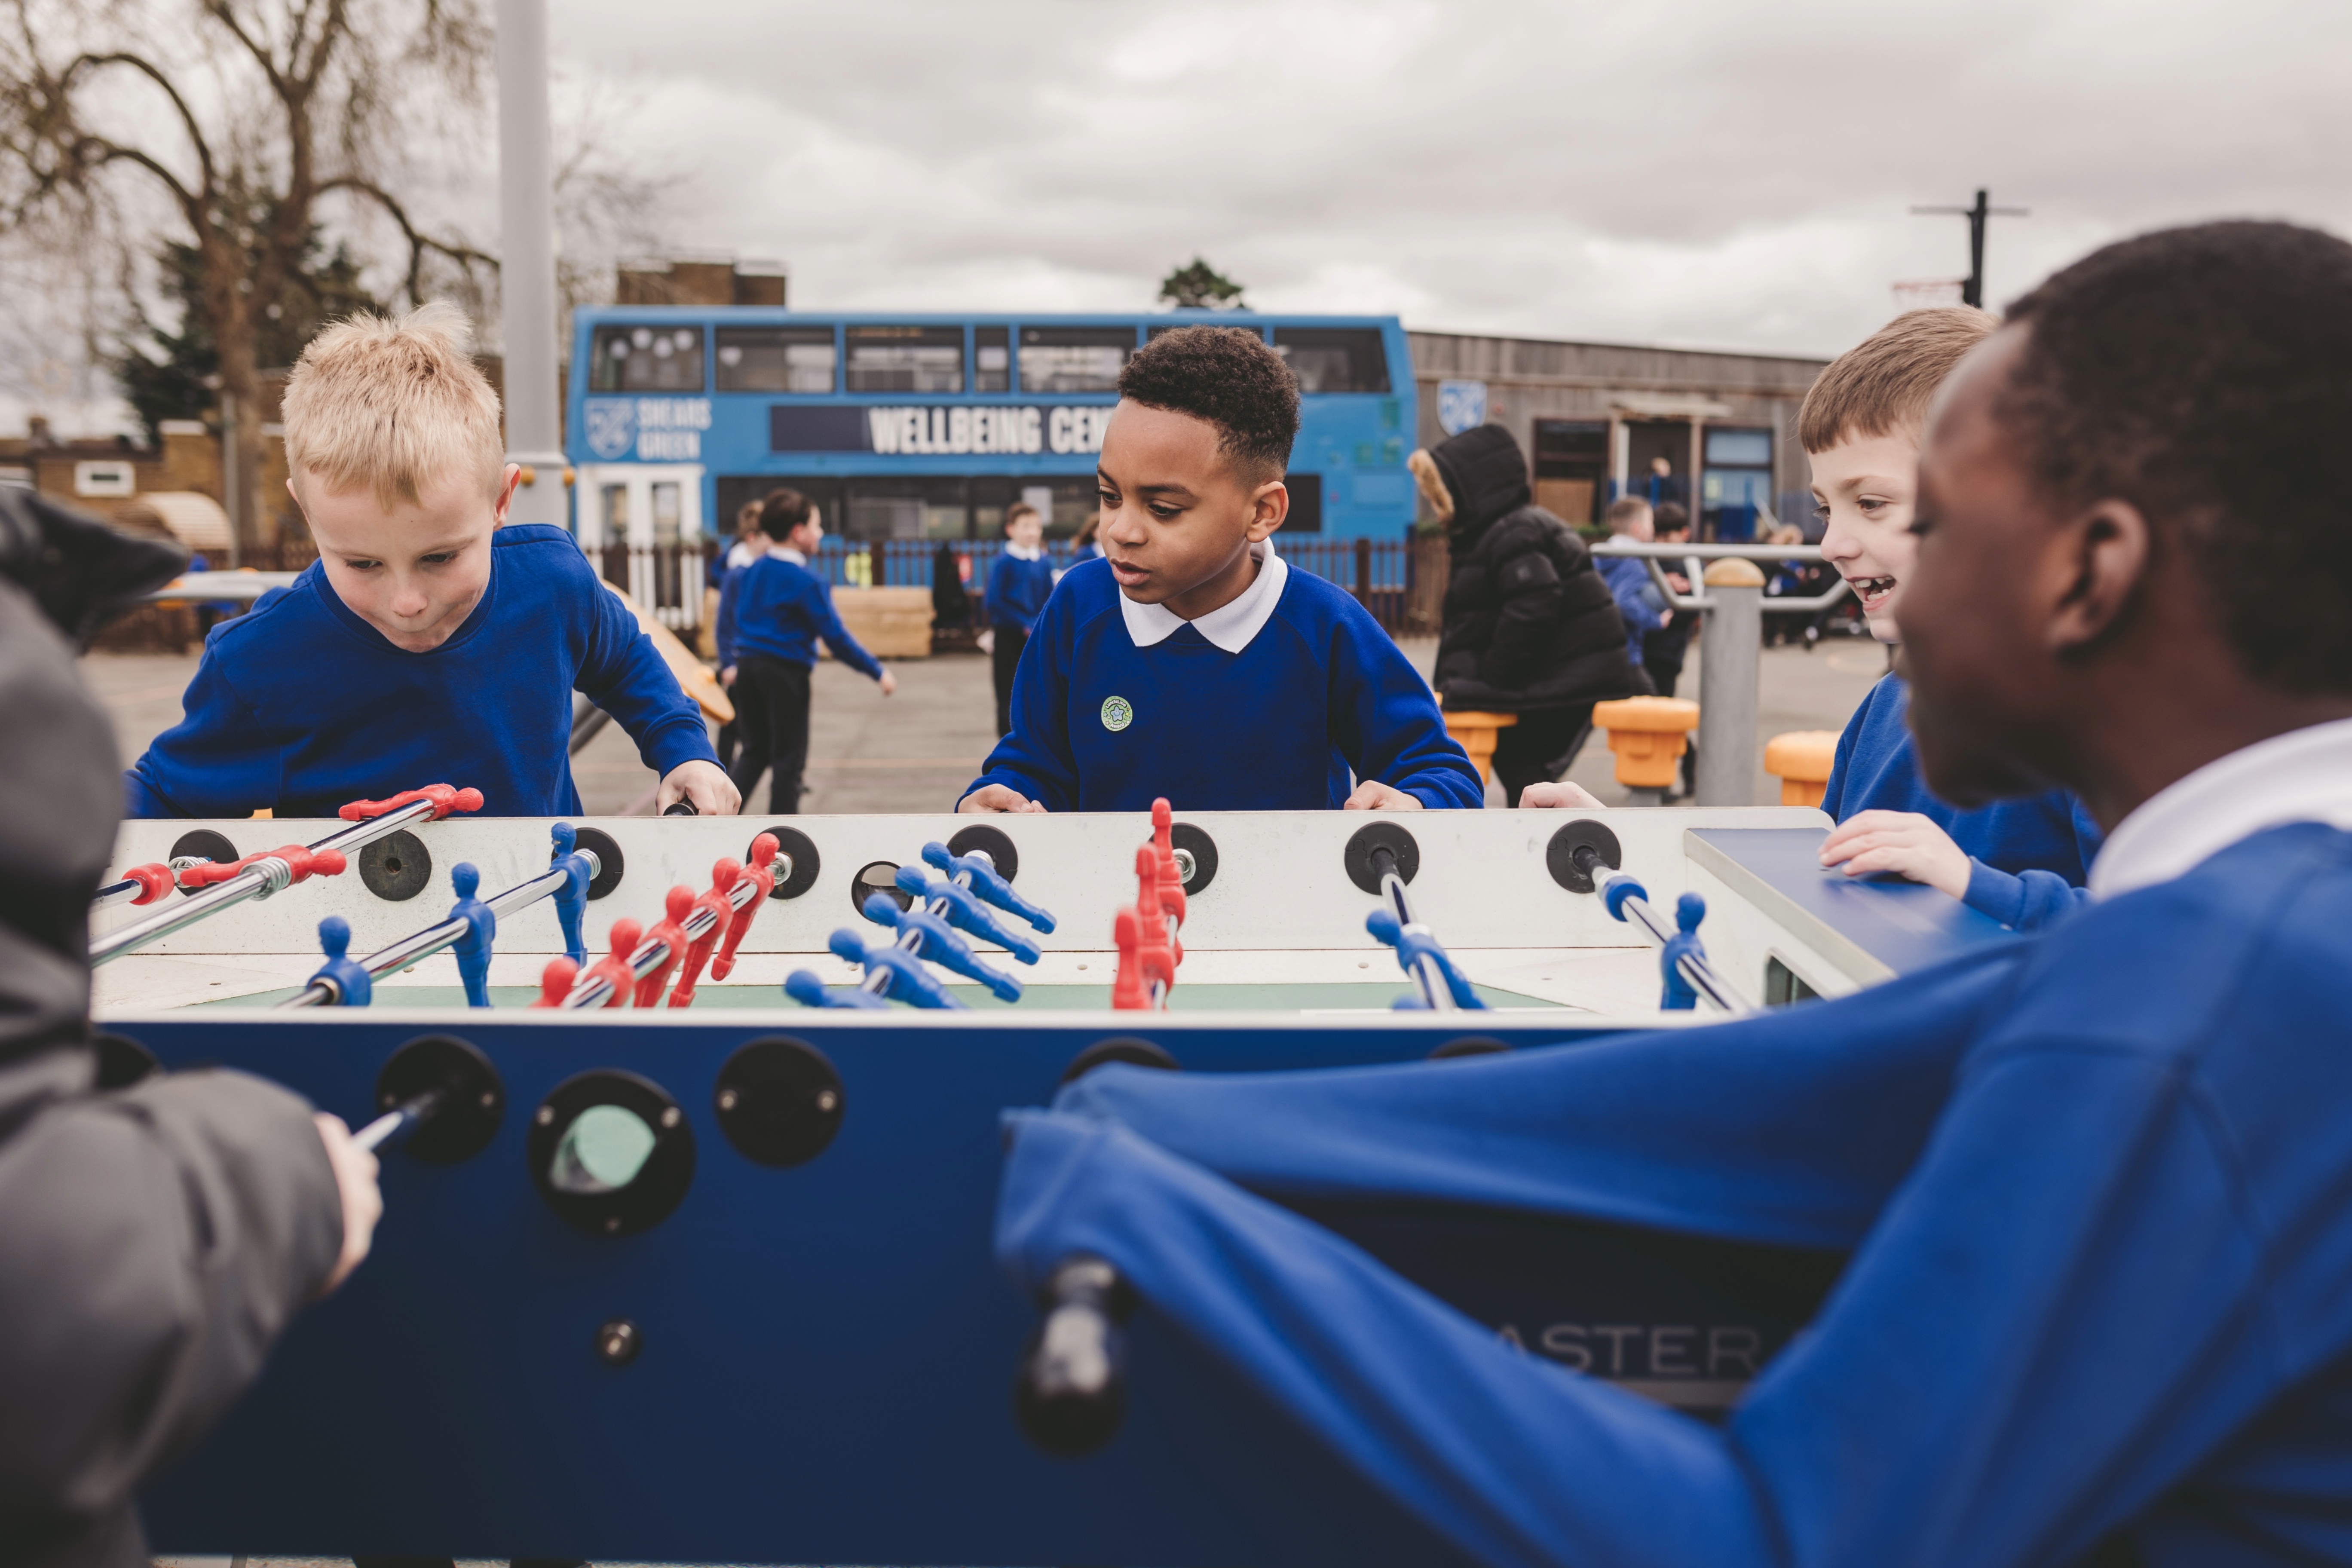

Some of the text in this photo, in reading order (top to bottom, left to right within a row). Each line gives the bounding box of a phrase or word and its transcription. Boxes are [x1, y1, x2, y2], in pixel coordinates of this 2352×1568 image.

[869, 406, 1116, 454] WELLBEING CEN
[637, 431, 701, 460] GREEN
[1105, 699, 1127, 708] Lunchtime
